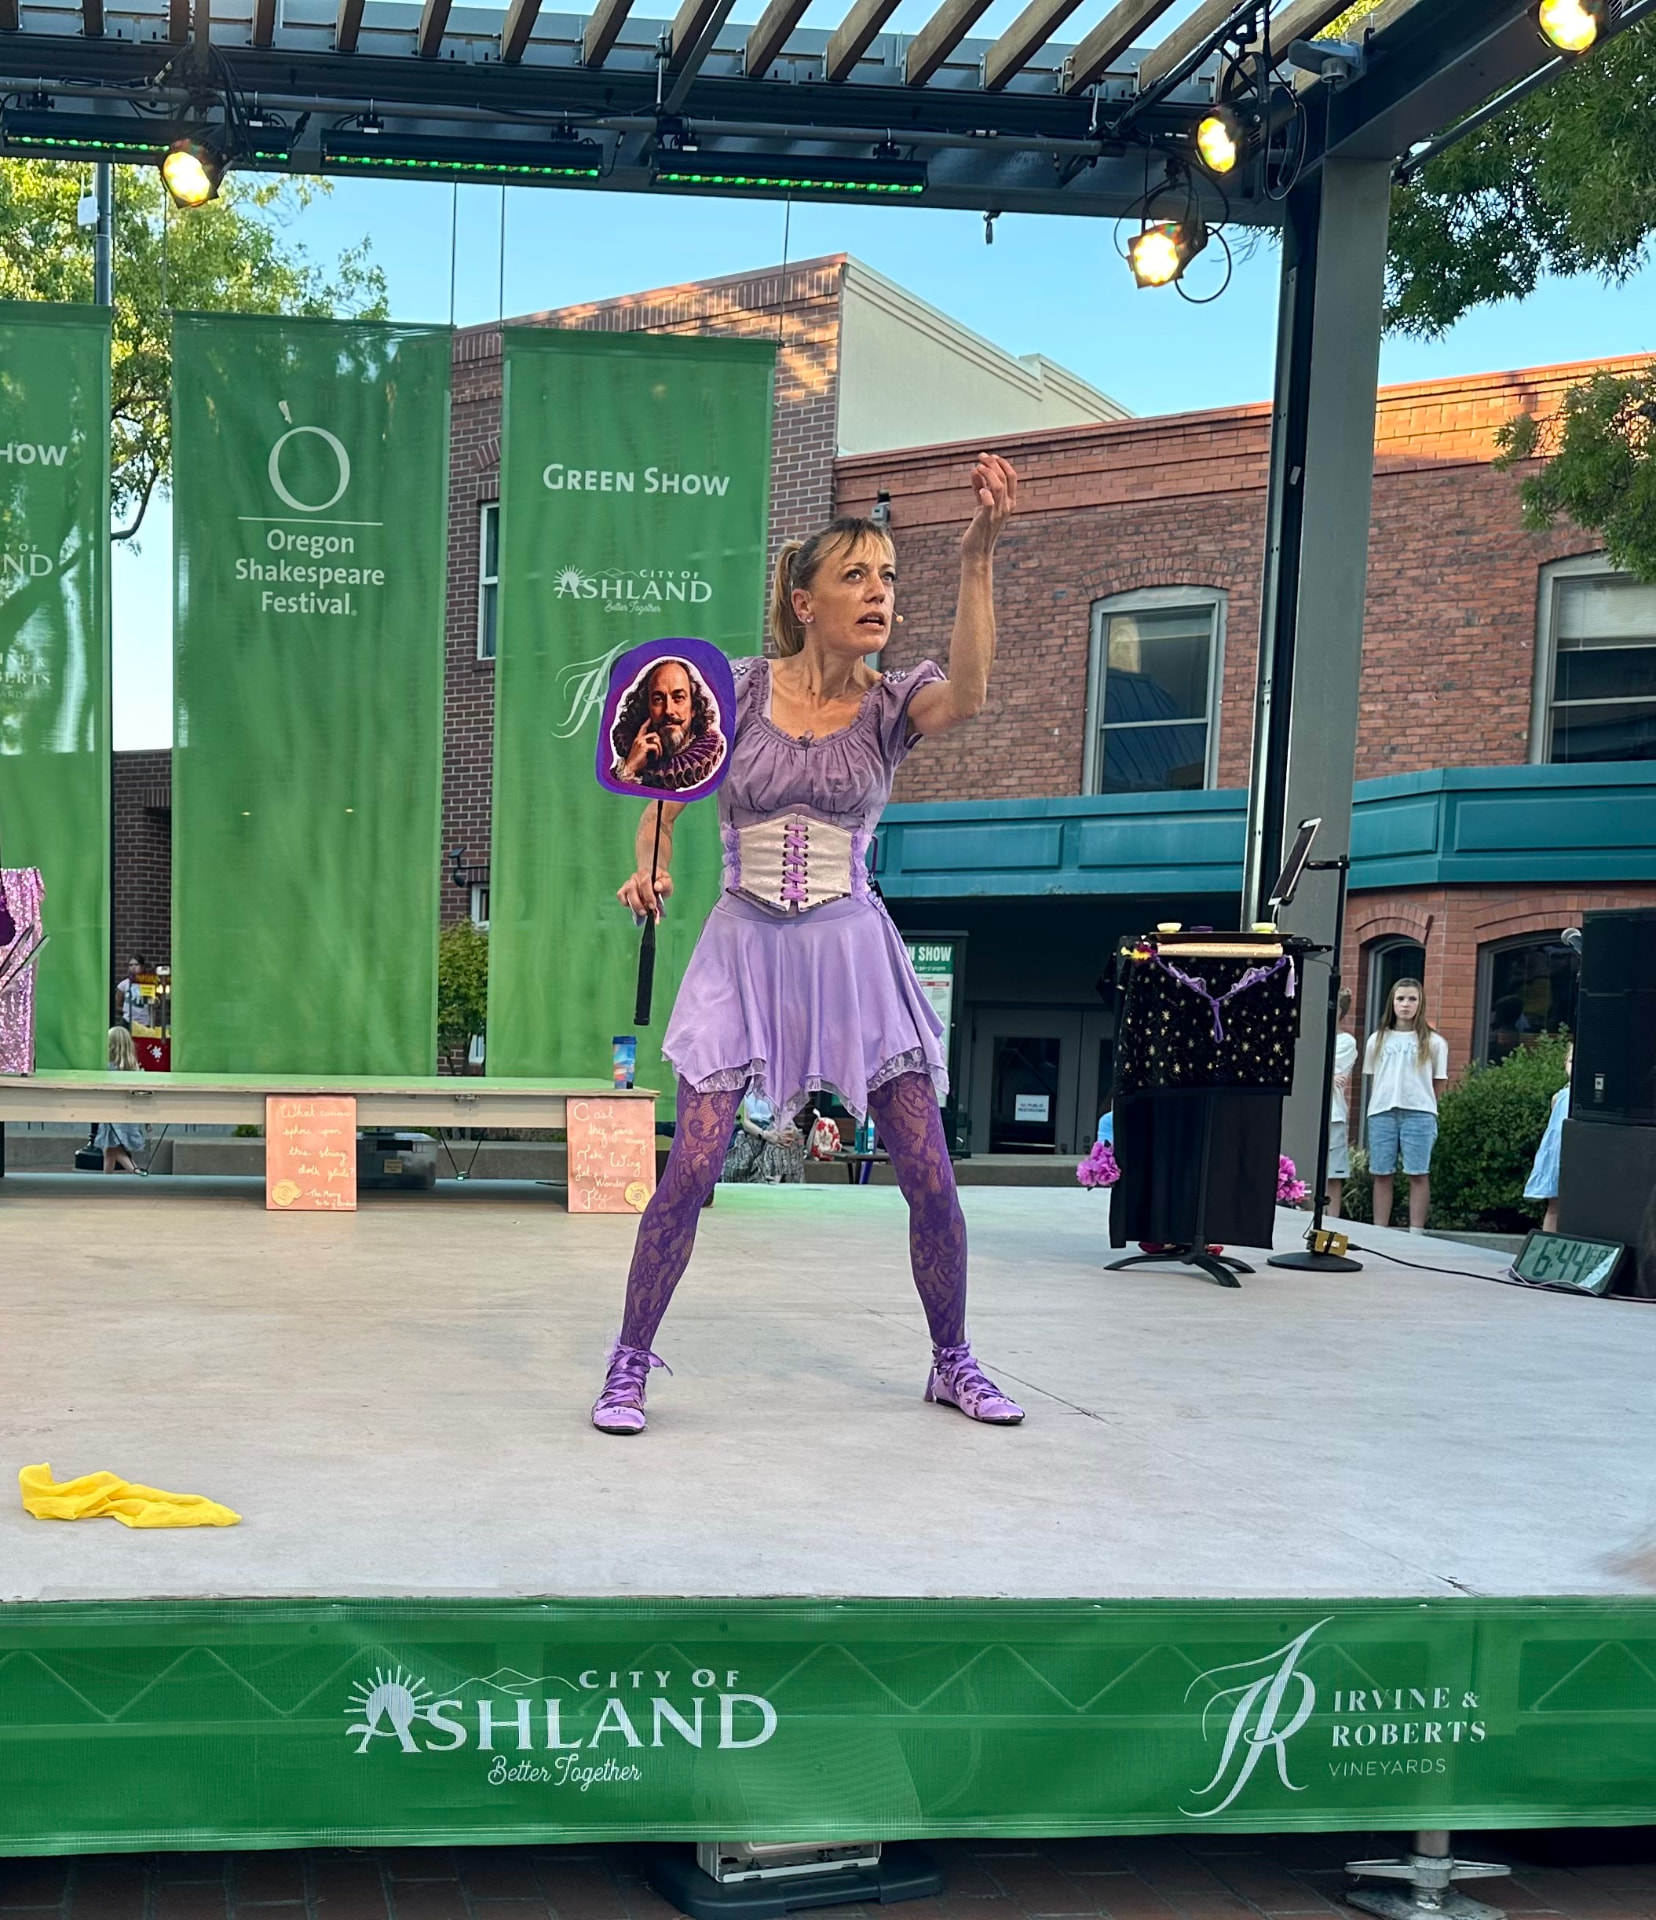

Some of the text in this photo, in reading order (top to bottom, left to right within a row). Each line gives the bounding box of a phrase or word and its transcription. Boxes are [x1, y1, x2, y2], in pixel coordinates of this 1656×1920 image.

[0, 441, 68, 467] HOW
[19, 543, 38, 553] OF
[266, 528, 355, 559] Oregon
[235, 557, 386, 590] Shakespeare
[639, 568, 700, 580] CITY OF
[553, 576, 713, 603] ASHLAND
[918, 946, 952, 962] SHOW
[573, 1102, 615, 1122] Cast
[608, 1151, 642, 1178] Wing
[579, 1668, 741, 1689] CITY OF
[1333, 1687, 1480, 1713] IRVINE &
[345, 1690, 779, 1754] ASHLAND
[1331, 1720, 1487, 1748] ROBERTS
[487, 1754, 643, 1792] Better Together
[1328, 1758, 1447, 1778] VINEYARDS
